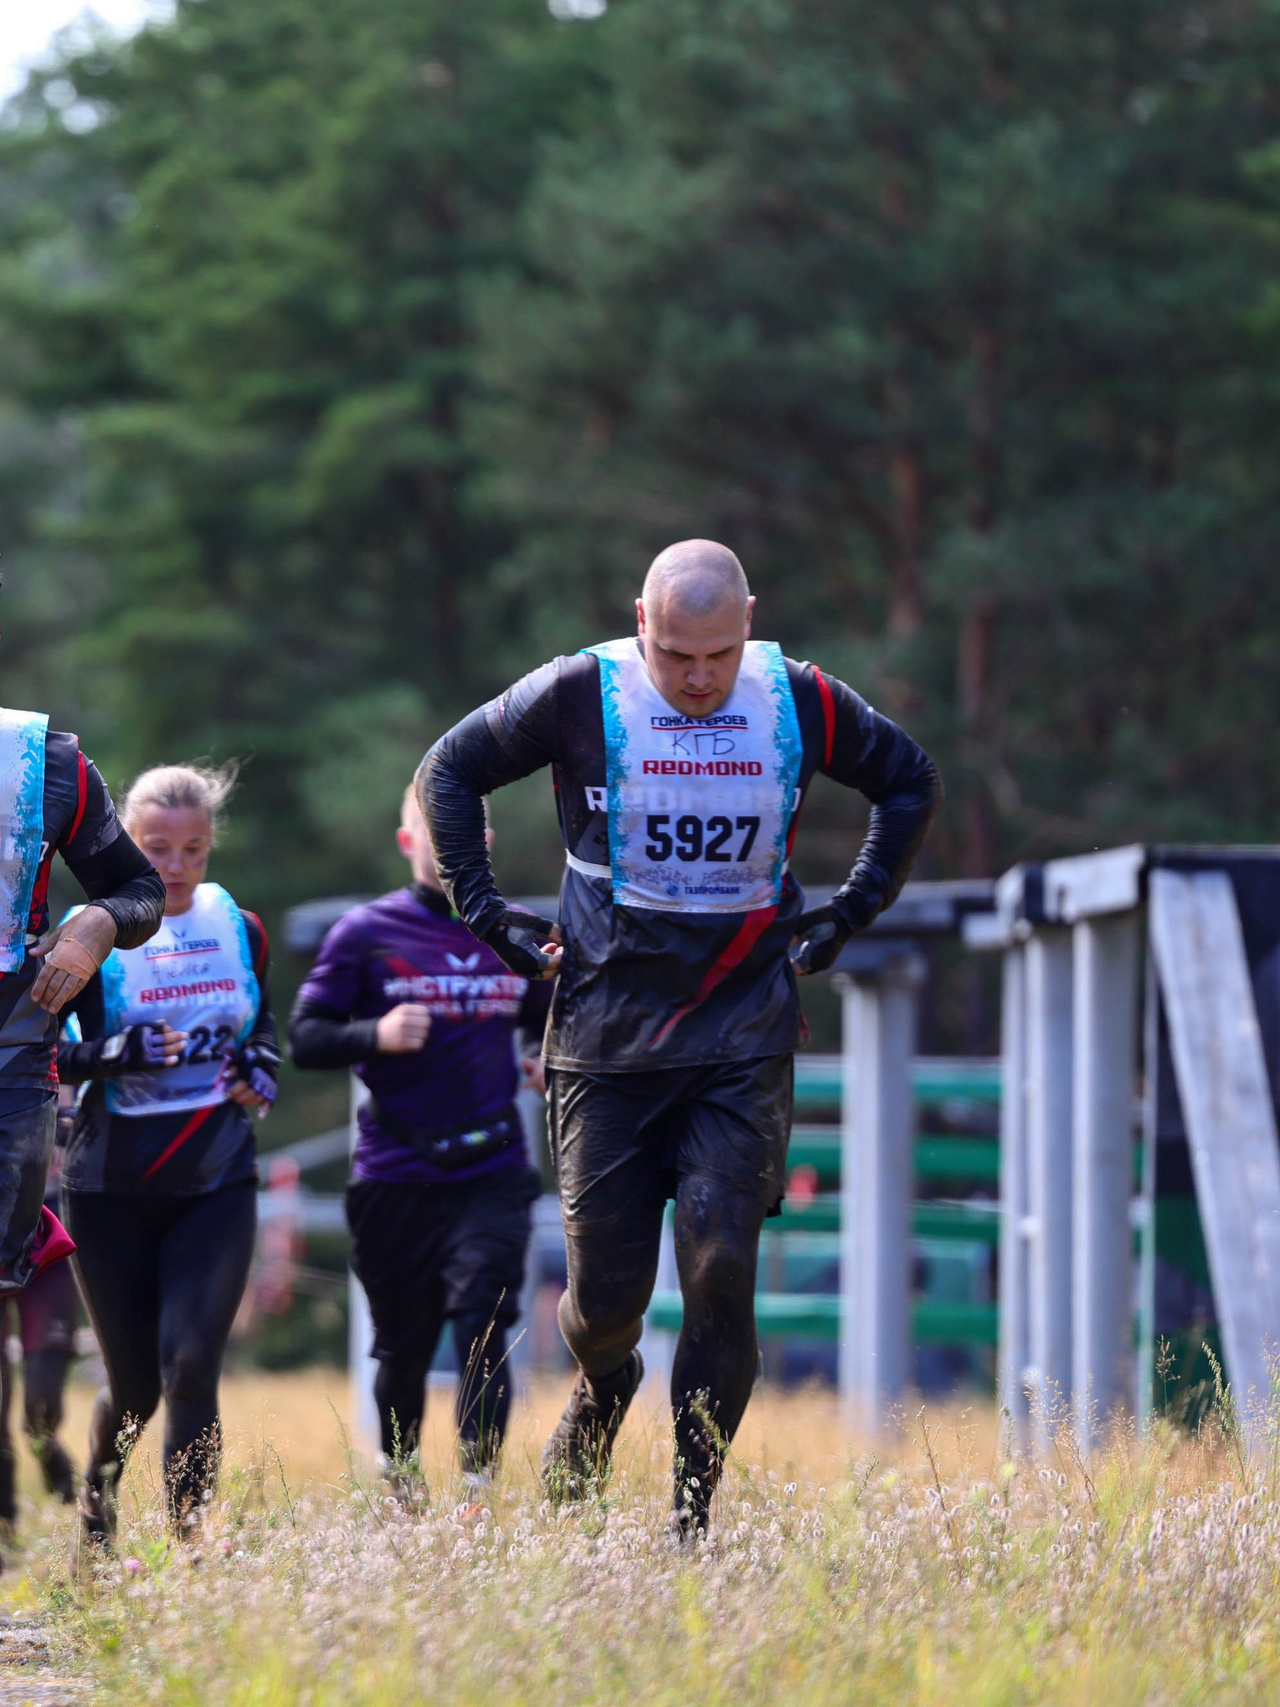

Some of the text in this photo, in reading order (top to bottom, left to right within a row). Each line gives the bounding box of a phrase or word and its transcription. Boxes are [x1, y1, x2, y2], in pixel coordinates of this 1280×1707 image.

[651, 715, 694, 727] ГОНКА
[672, 729, 735, 756] КГБ
[645, 814, 761, 862] 5927
[684, 886, 741, 895] ГАЗПРОМБАНК
[144, 943, 180, 957] ГОНКА
